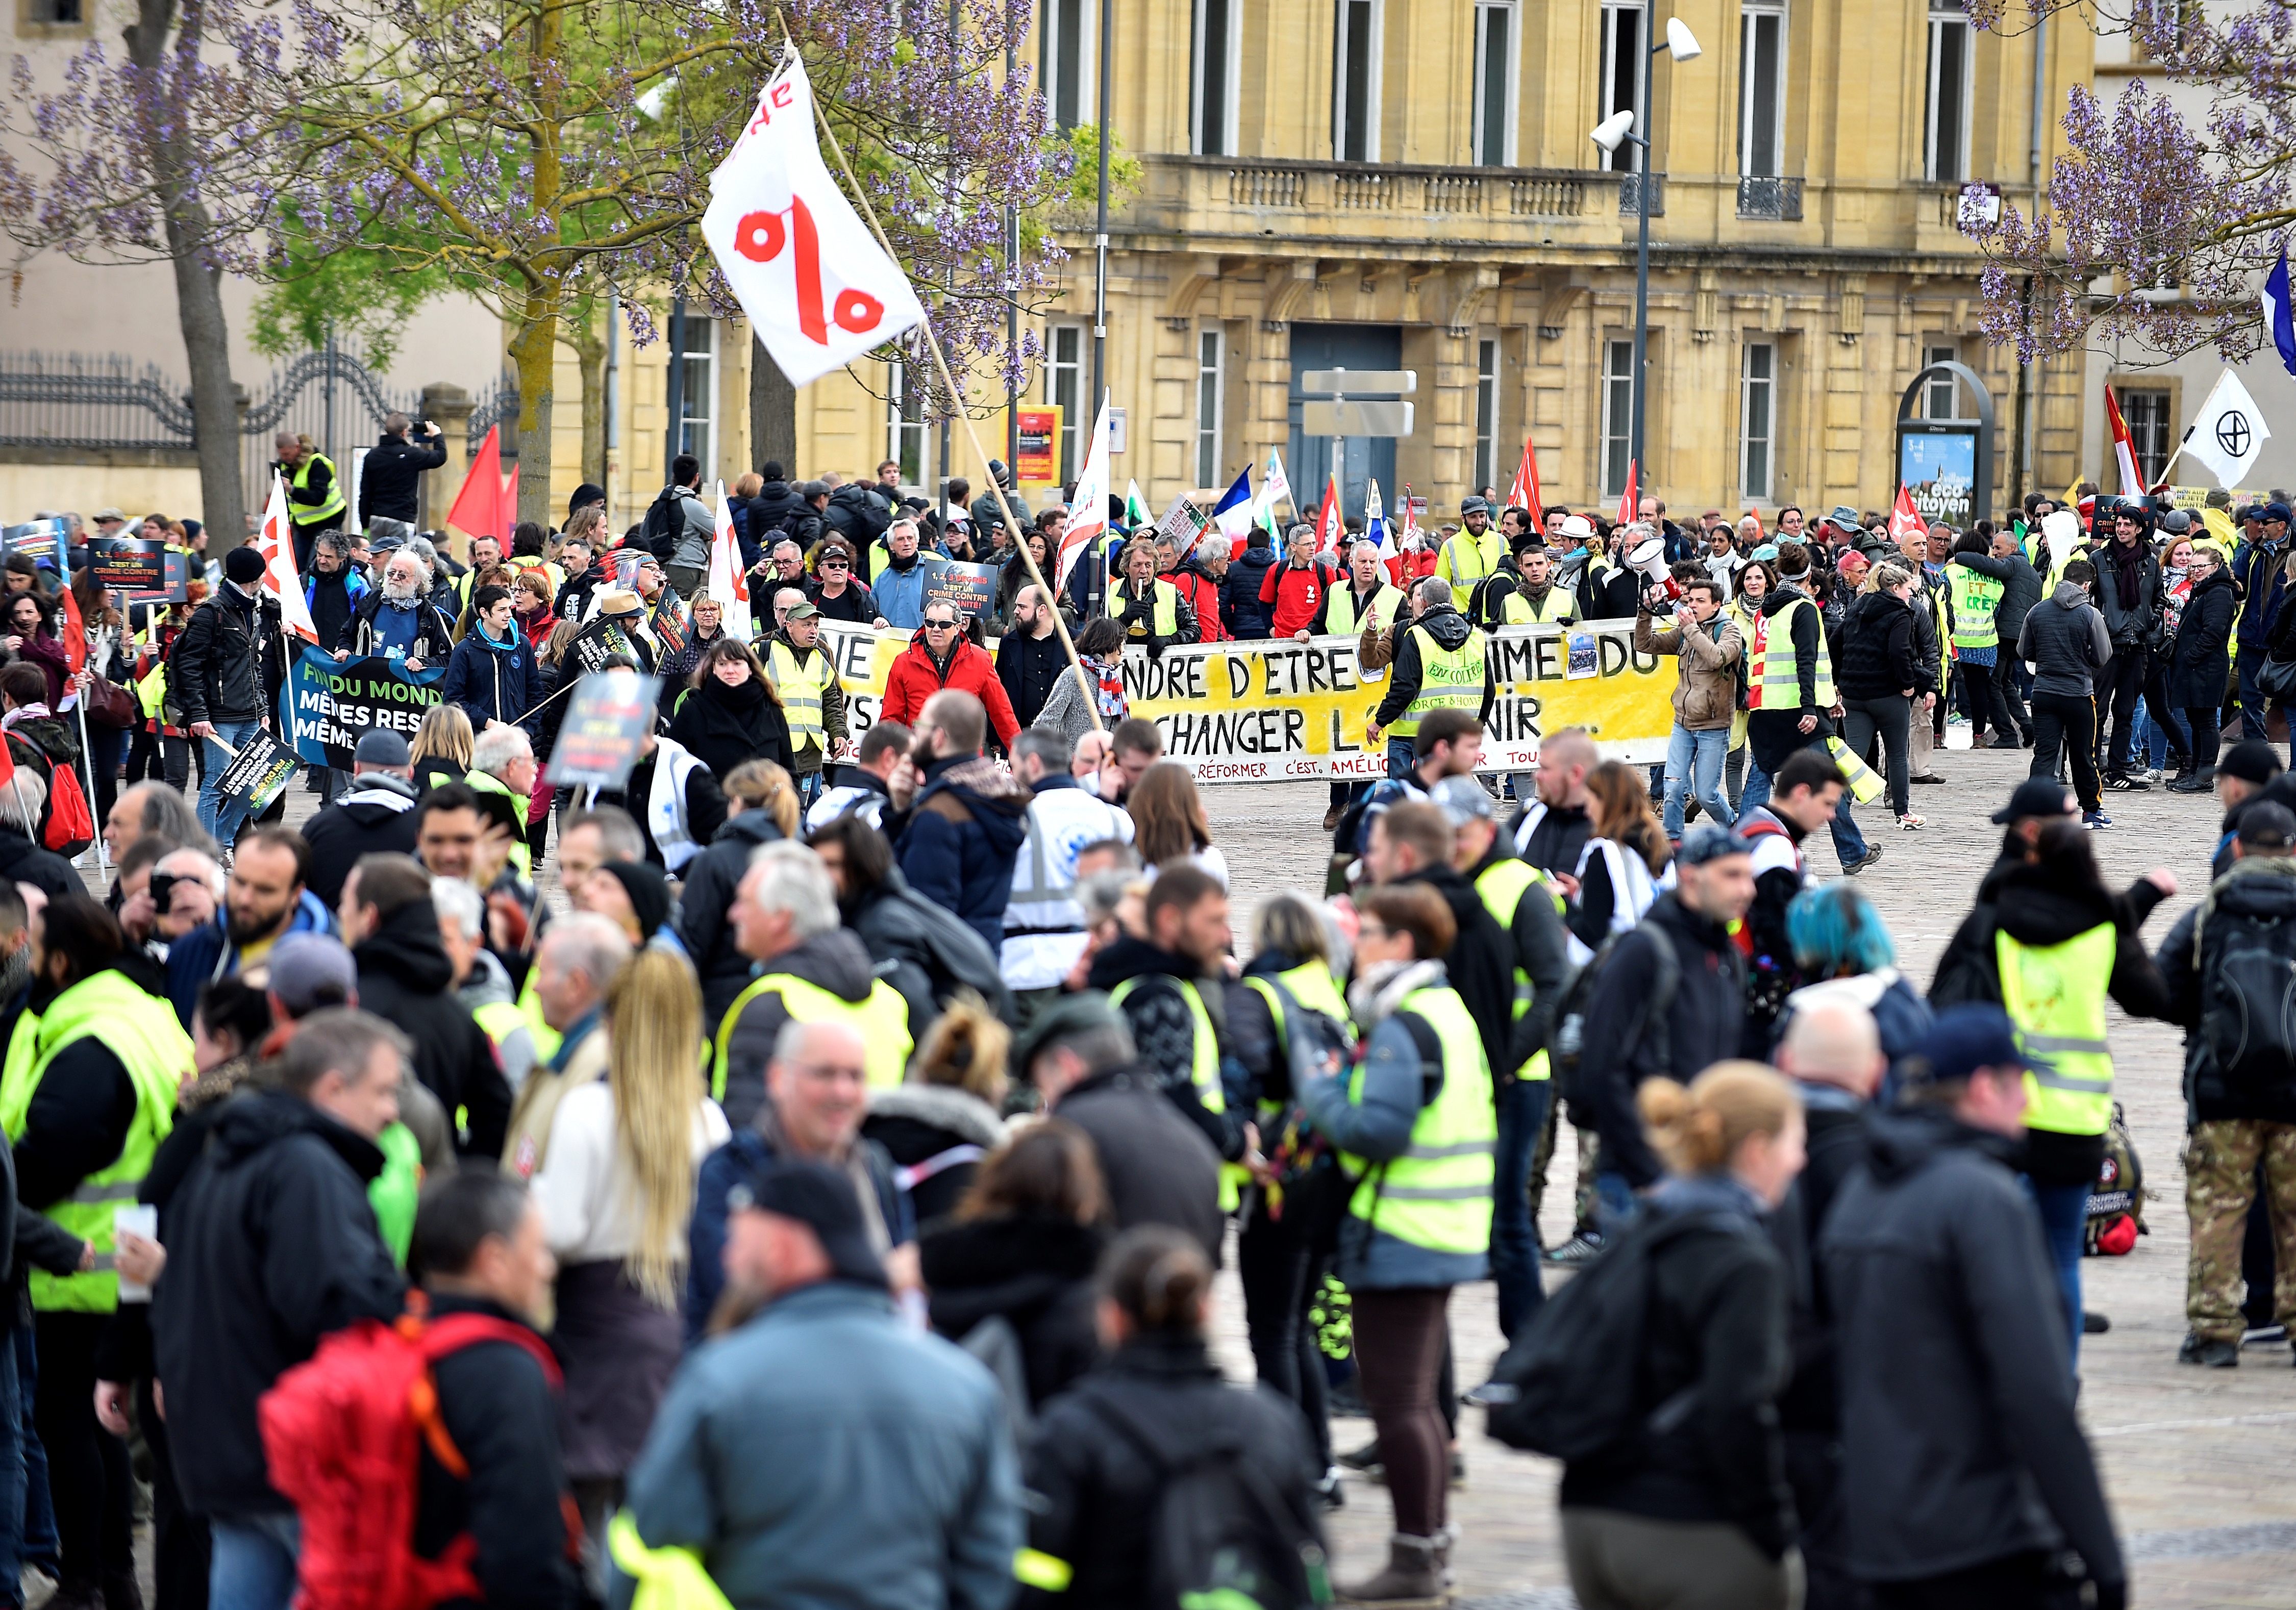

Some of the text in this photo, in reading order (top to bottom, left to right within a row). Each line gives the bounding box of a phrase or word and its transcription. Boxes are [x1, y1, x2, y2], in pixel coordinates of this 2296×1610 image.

[932, 572, 938, 581] 1,
[939, 573, 947, 581] 2,
[1968, 582, 1987, 595] ET
[928, 589, 988, 602] CRIME CONTRE
[957, 600, 982, 609] ANITÉ!
[602, 632, 614, 646] FIN
[605, 623, 616, 637] FIN
[657, 612, 671, 631] CRIME
[670, 628, 685, 649] CONTRE
[577, 638, 596, 663] MÊME
[1121, 631, 1659, 701] NDRE D'ETRE IME DU
[1429, 664, 1448, 677] EN
[303, 662, 444, 707] FIN DU MOND
[1409, 697, 1446, 710] ORCE
[375, 708, 425, 733] RES
[296, 717, 356, 750] MÊME
[249, 735, 272, 760] MÊME
[231, 742, 278, 796] RESPONSABLES
[248, 760, 272, 788] MÊMES
[274, 771, 285, 782] DU
[283, 758, 296, 772] FIN
[1197, 759, 1268, 779] RÉFORMER
[1330, 753, 1389, 771] AMÉLIO
[1506, 751, 1537, 764] TOU
[249, 758, 286, 802] FIN DU MOIS
